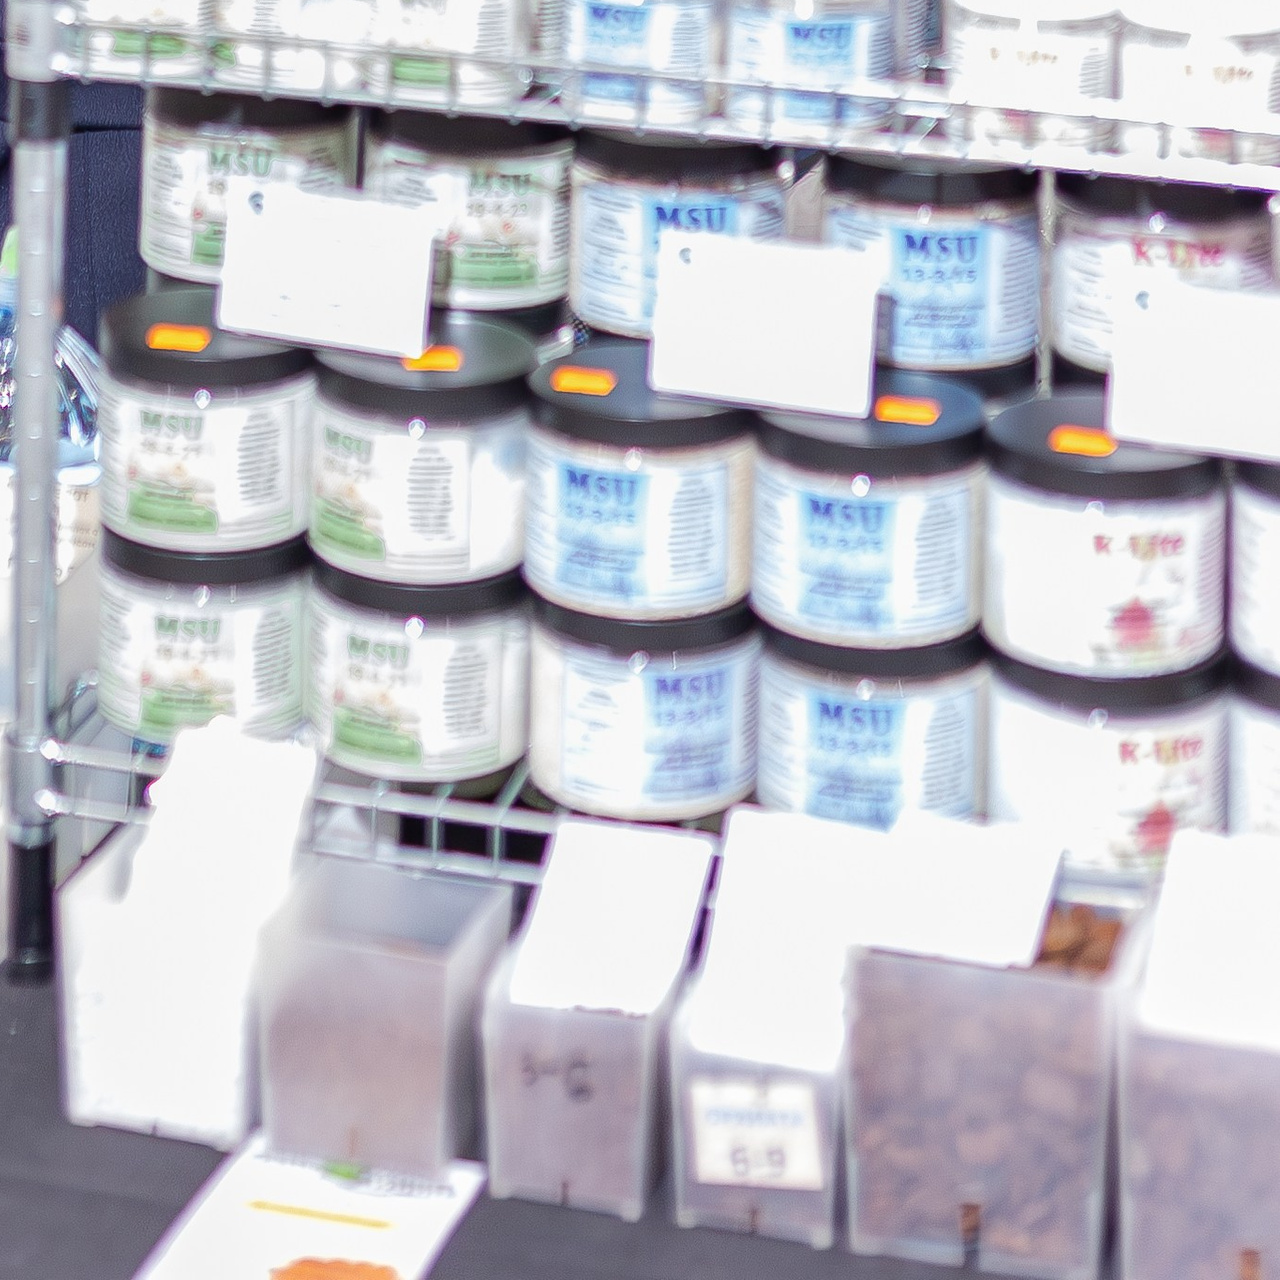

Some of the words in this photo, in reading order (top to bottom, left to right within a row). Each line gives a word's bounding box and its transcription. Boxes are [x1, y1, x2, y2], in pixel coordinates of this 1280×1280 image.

[904, 233, 979, 264] MSU
[566, 468, 638, 507] MSU
[808, 497, 887, 534] MSU
[654, 673, 726, 703] MSU
[818, 701, 894, 738] MSU
